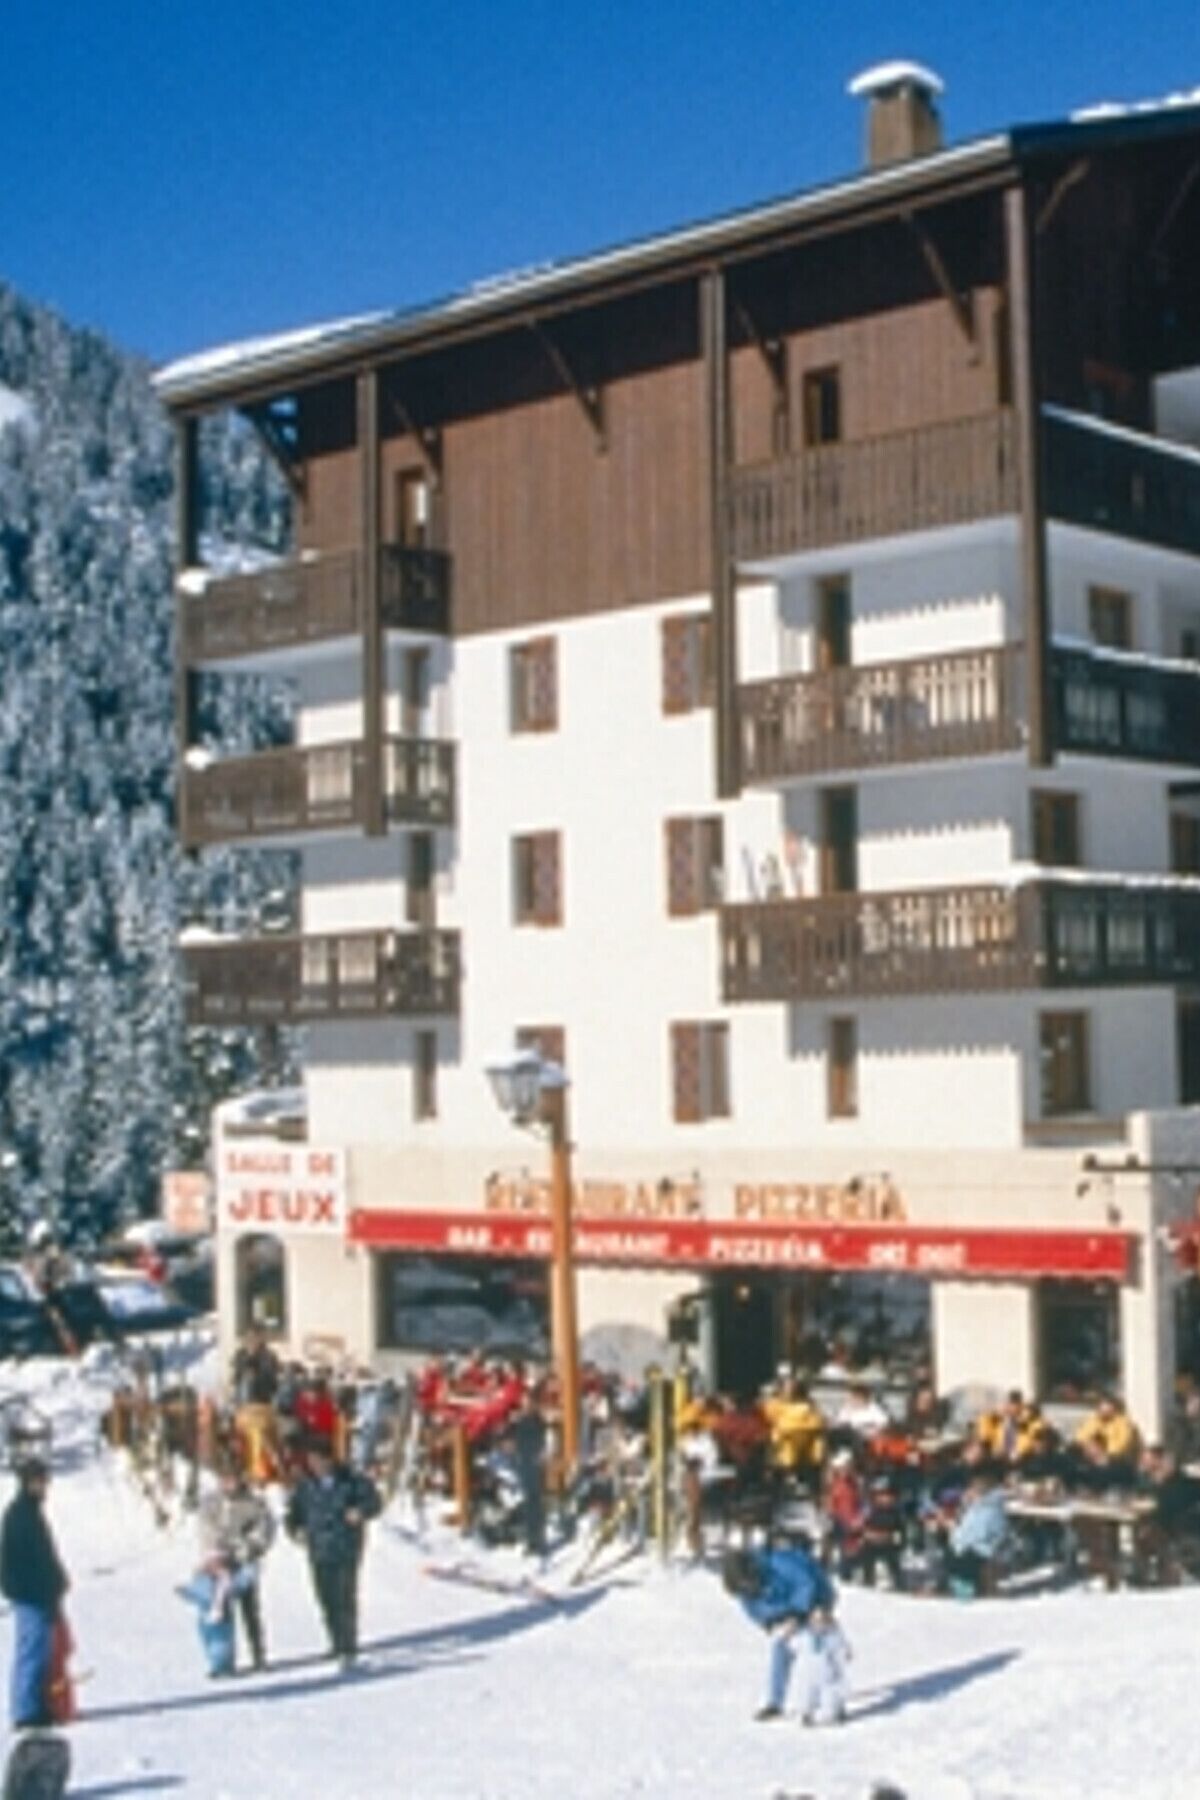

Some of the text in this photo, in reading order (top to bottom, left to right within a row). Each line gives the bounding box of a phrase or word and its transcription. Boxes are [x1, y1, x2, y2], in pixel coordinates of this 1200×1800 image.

[309, 1153, 334, 1174] DE
[228, 1189, 335, 1221] JEUX
[485, 1178, 908, 1221] RESAURANT PIZZERIA
[447, 1227, 492, 1251] BAR
[526, 1229, 669, 1258] REAURANT
